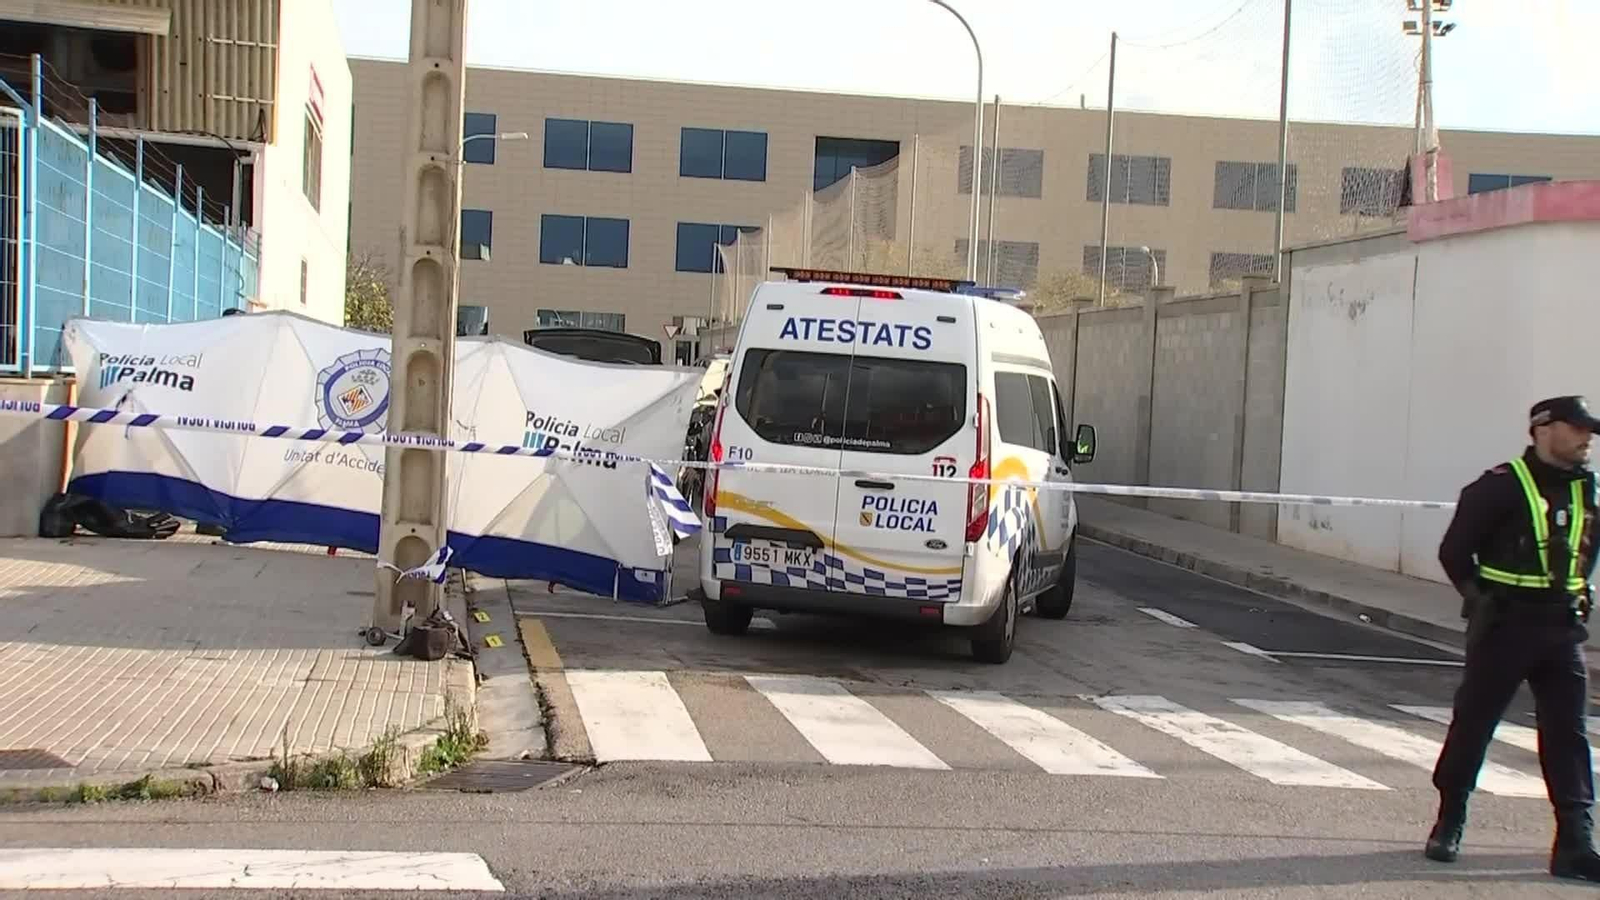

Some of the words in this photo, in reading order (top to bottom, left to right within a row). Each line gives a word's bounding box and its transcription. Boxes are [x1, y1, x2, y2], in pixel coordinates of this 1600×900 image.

[779, 317, 932, 350] ATESTATS
[160, 353, 203, 368] Local
[117, 367, 195, 391] Palma
[583, 424, 626, 444] Local
[823, 435, 891, 448] @policiadepalma
[284, 449, 320, 461] Unitat
[728, 446, 753, 460] F10
[932, 464, 957, 478] 112
[861, 495, 938, 515] POLICIA
[875, 513, 935, 533] LOCAL
[744, 545, 778, 563] 9551
[784, 550, 812, 566] MKX
